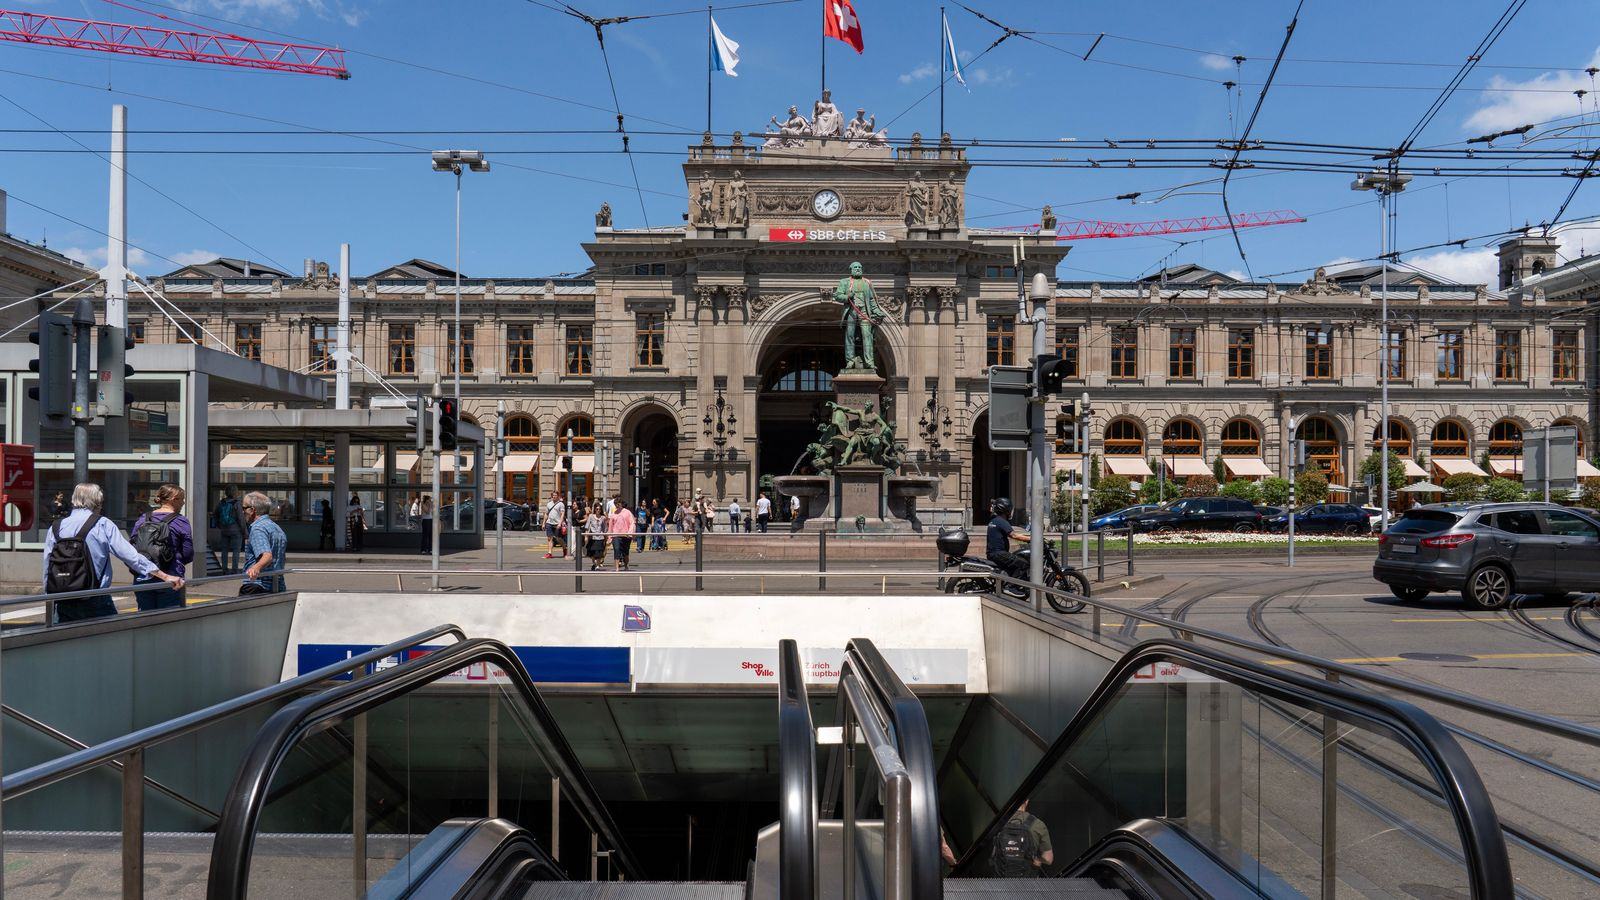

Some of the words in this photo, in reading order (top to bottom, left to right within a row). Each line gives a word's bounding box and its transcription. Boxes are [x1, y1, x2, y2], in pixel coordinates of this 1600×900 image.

[809, 229, 834, 241] SBB
[863, 230, 886, 241] FFS
[741, 661, 764, 672] Shop
[754, 669, 774, 677] Ville
[807, 670, 840, 678] auptba
